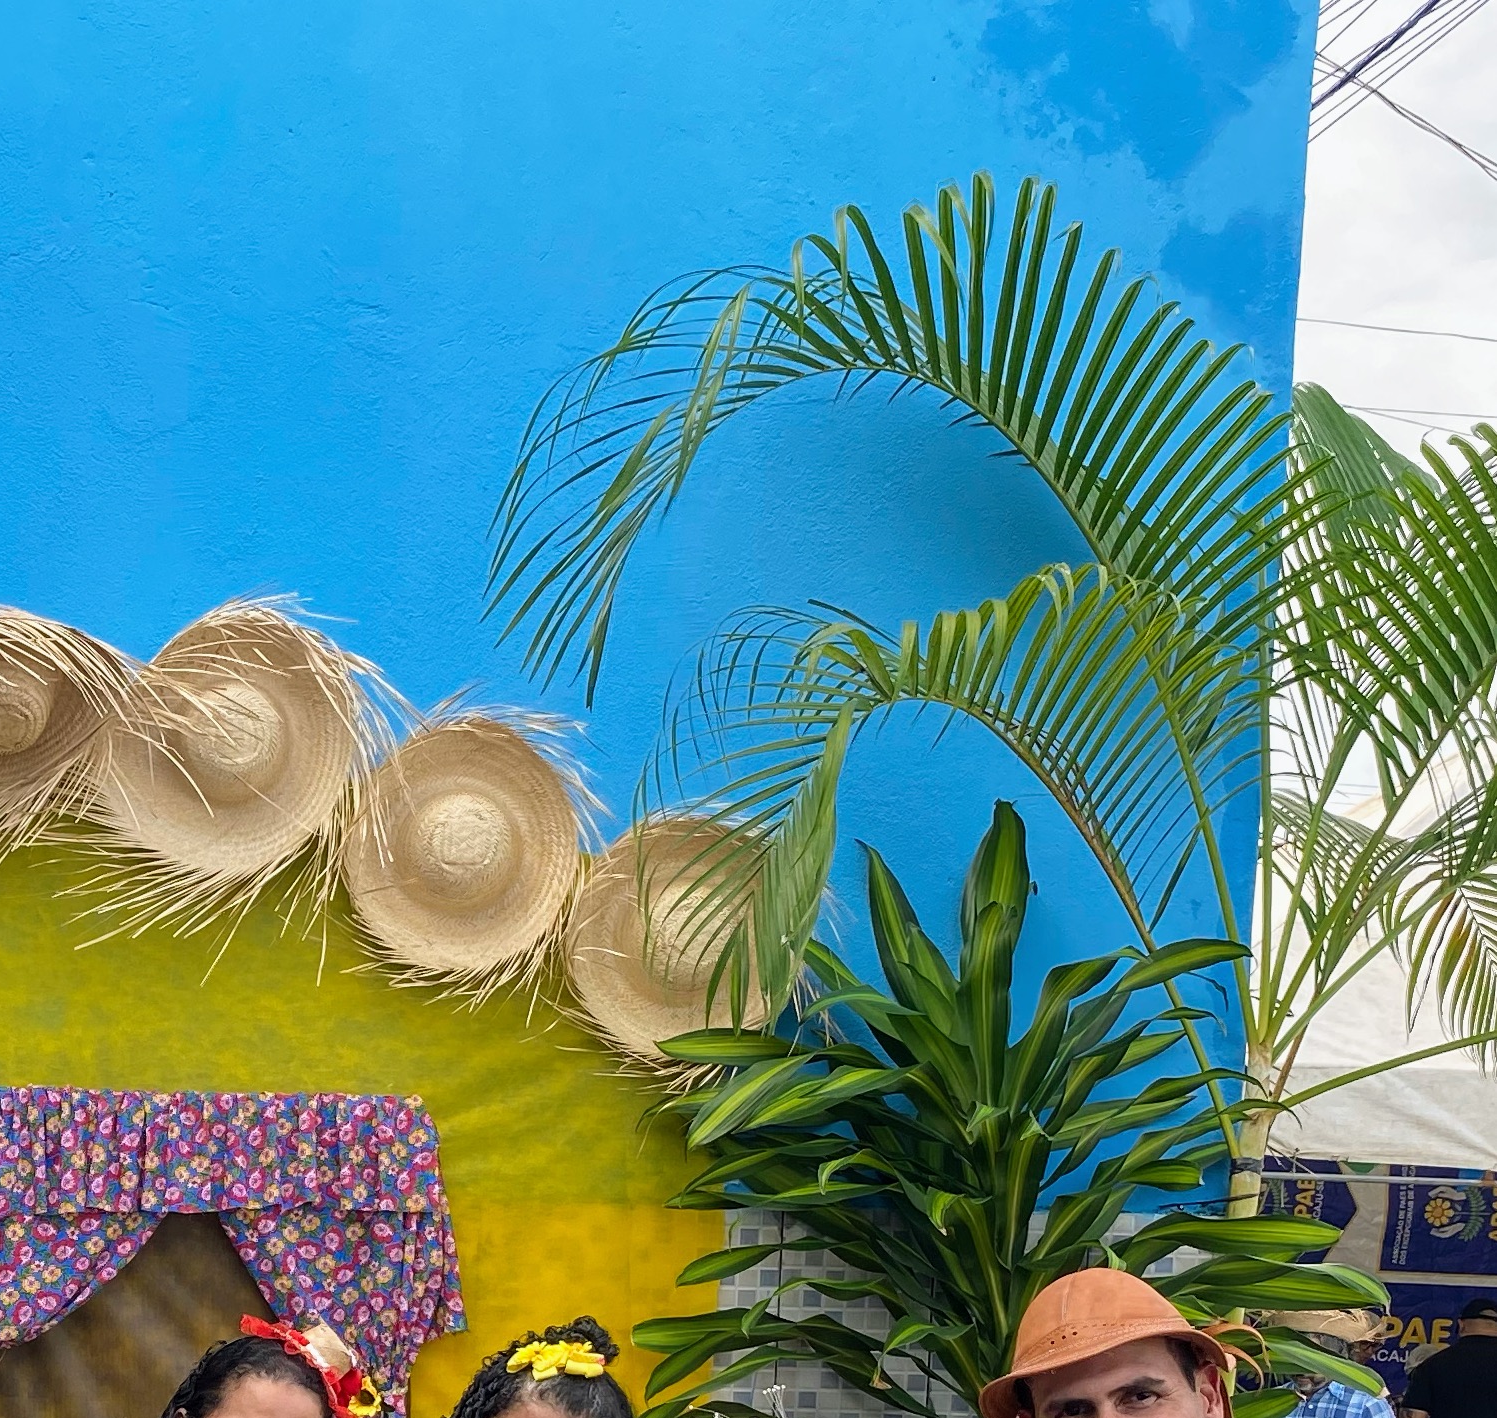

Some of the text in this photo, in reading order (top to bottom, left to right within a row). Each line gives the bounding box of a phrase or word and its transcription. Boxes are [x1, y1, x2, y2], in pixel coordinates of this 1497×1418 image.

[1294, 1180, 1315, 1219] PAE
[1312, 1181, 1324, 1219] CAJU-S
[1380, 1316, 1453, 1349] PAE
